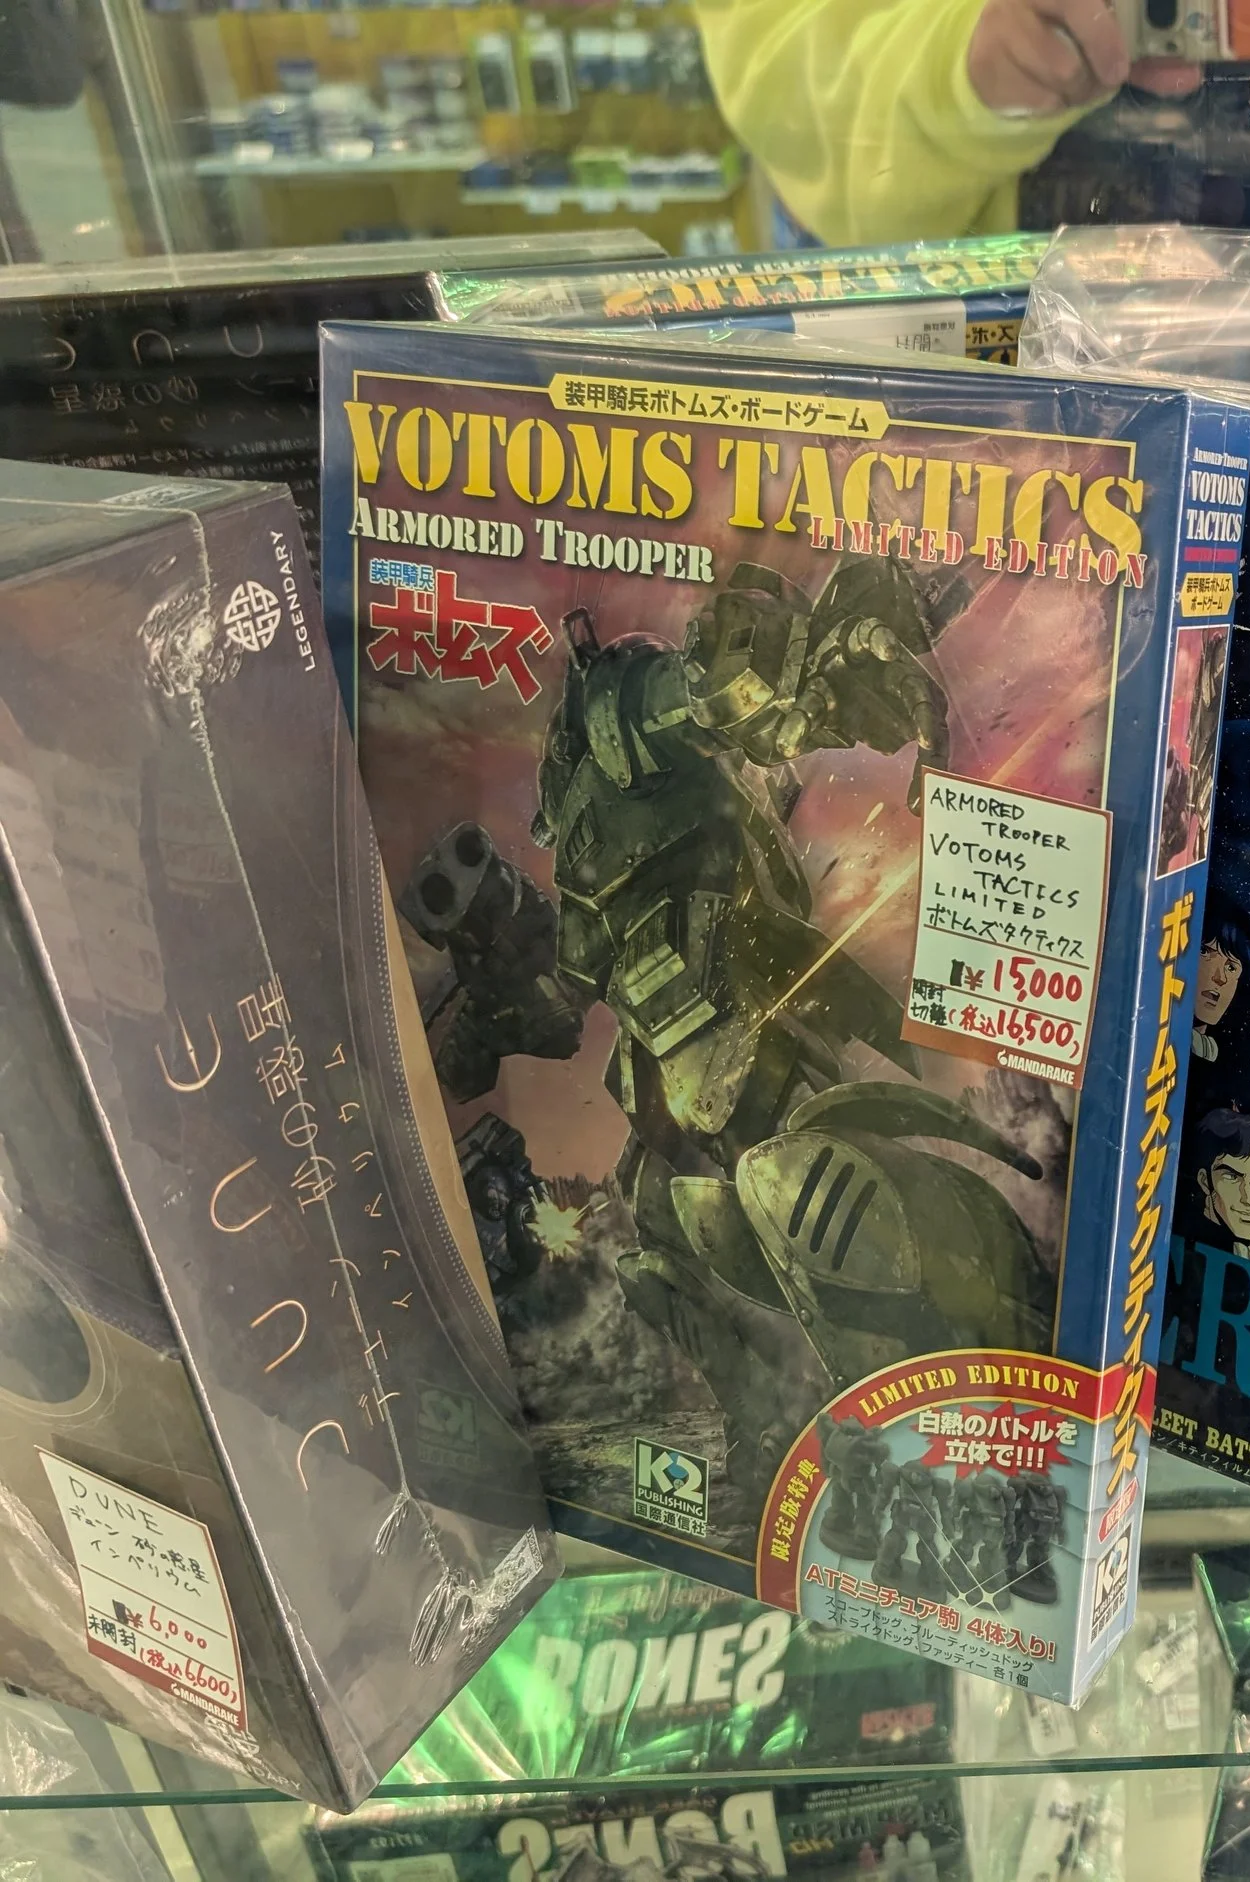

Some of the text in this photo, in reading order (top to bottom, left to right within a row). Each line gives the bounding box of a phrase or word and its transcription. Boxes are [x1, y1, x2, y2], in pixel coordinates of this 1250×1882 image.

[565, 380, 869, 432] 装甲騎兵ボトムズ・ボードゲーム
[343, 401, 1144, 574] VOTOMS TACTICS
[1190, 470, 1246, 507] VOTOMS
[348, 497, 524, 558] ARMORED
[536, 518, 715, 583] TROOPER
[1186, 509, 1243, 543] TACTICS
[810, 516, 1147, 589] LIMITED EDITION
[370, 558, 434, 590] 装甲騎兵
[270, 530, 316, 672] LEGENDARY
[1191, 596, 1223, 612] ボードゲーム
[367, 569, 554, 706] ボトムズ
[930, 787, 1025, 820] ARMORED
[930, 833, 1026, 871] VOTOMS
[981, 821, 1071, 851] TROOPER
[935, 882, 1046, 919] LIMITED
[973, 871, 1080, 908] TACTICS
[926, 903, 1084, 959] ボトムズタクティクス
[1007, 1054, 1075, 1086] MANDARAKE
[1107, 891, 1194, 1496] ボトムズタクティクス
[858, 1364, 1080, 1417] LIMITED EDITION
[918, 1409, 1078, 1446] 白熱のバトルを
[1153, 1405, 1198, 1441] LEET
[945, 1439, 1045, 1469] 立体で!!!
[638, 1443, 704, 1504] K2
[69, 1475, 164, 1536] DUNE
[635, 1502, 707, 1537] 国際通信社
[637, 1487, 704, 1517] PUBLISHING
[770, 1458, 820, 1563] 限定版特典
[90, 1539, 202, 1597] インペリウム
[805, 1563, 1057, 1663] ATミニチュア駒 4体入り!
[179, 1687, 239, 1726] MANDARAKE
